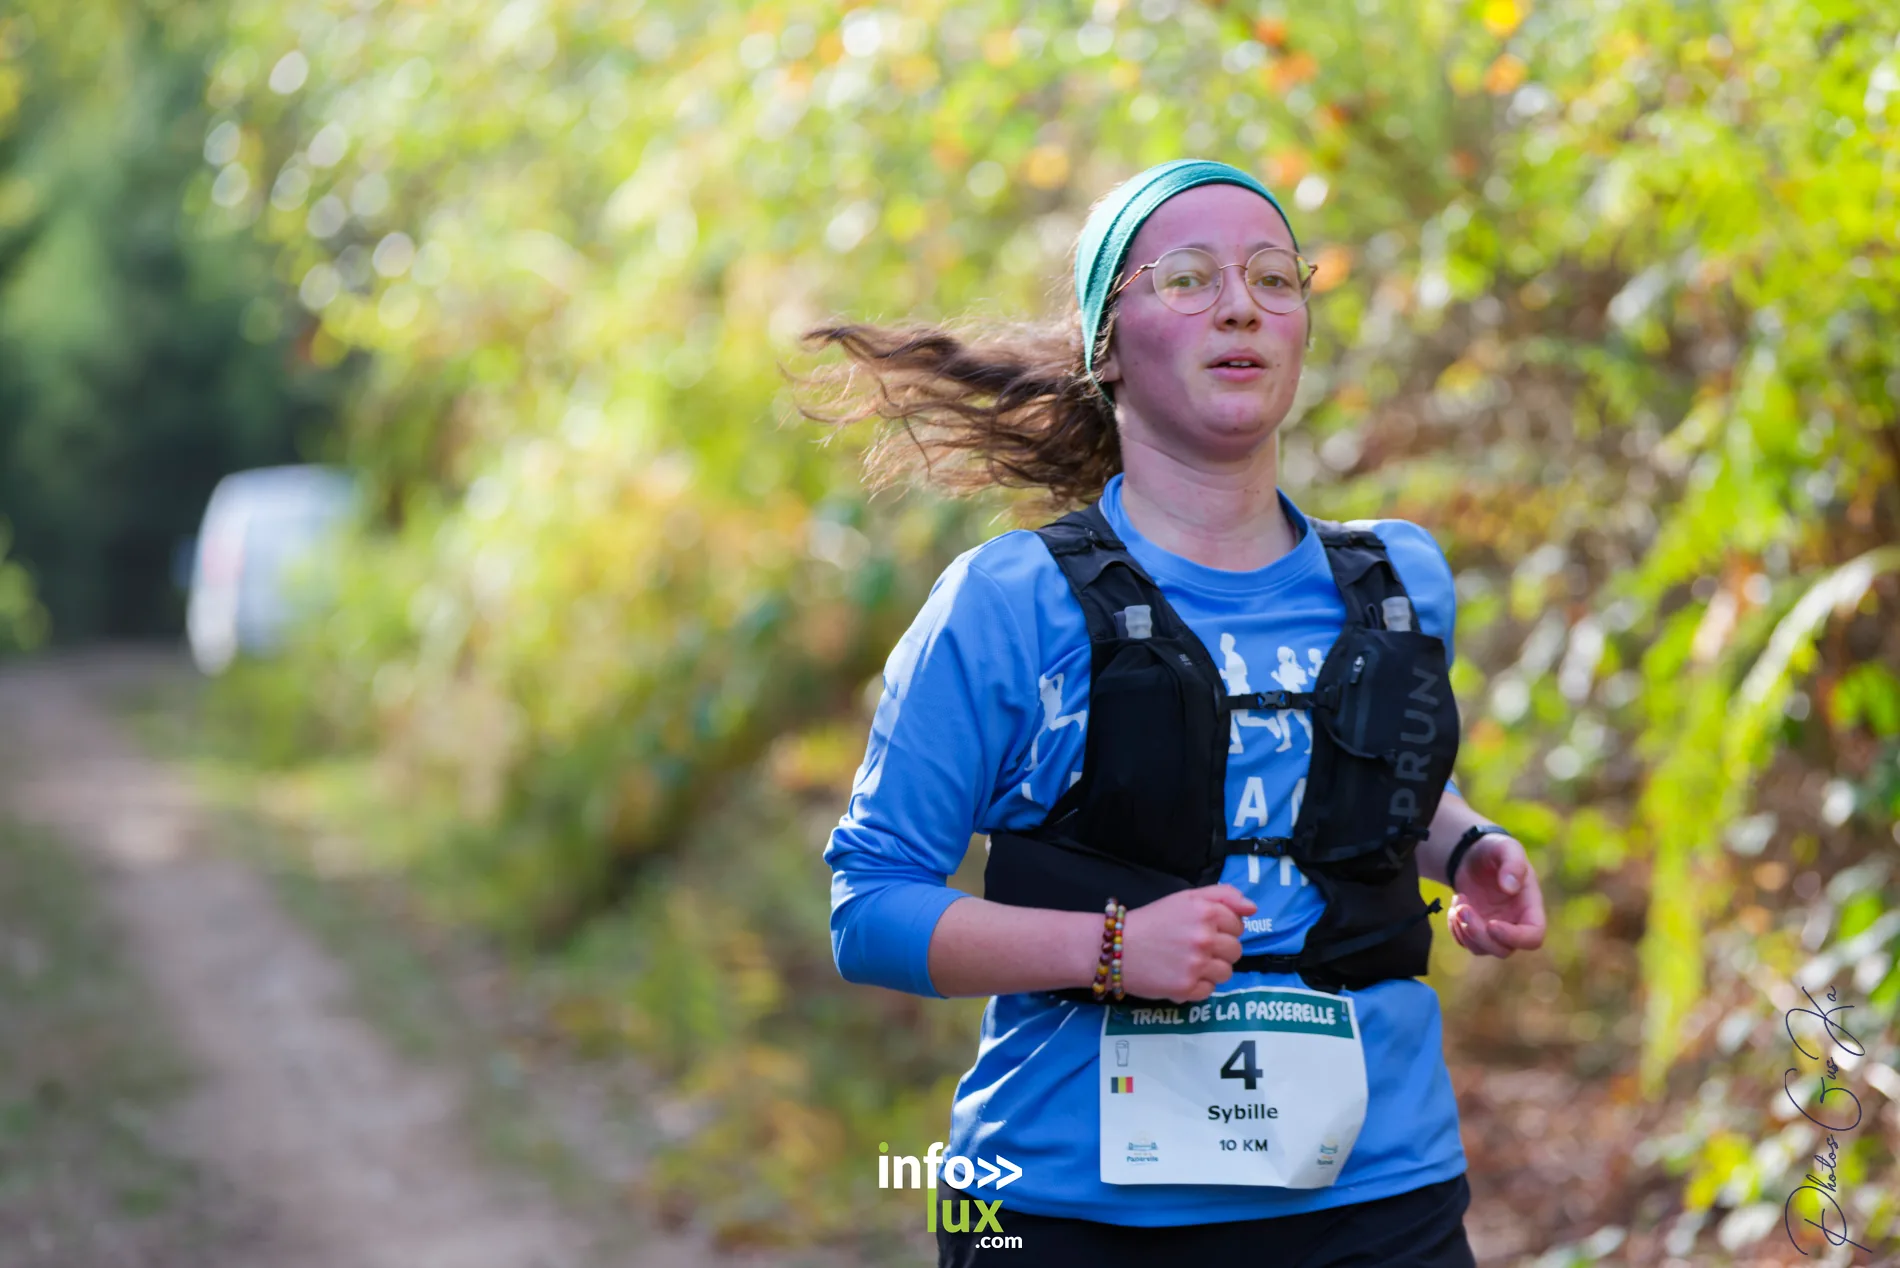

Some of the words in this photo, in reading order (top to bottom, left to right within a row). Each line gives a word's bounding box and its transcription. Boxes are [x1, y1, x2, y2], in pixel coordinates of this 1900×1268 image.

[1131, 1008, 1185, 1026] TRAIL
[1188, 1004, 1212, 1024] DE
[1215, 1001, 1241, 1021] LA
[1245, 1000, 1336, 1025] PASSERELLE
[1220, 1040, 1263, 1090] 4
[1207, 1104, 1279, 1123] Sybille
[1219, 1139, 1237, 1152] 10
[1243, 1139, 1268, 1152] KM
